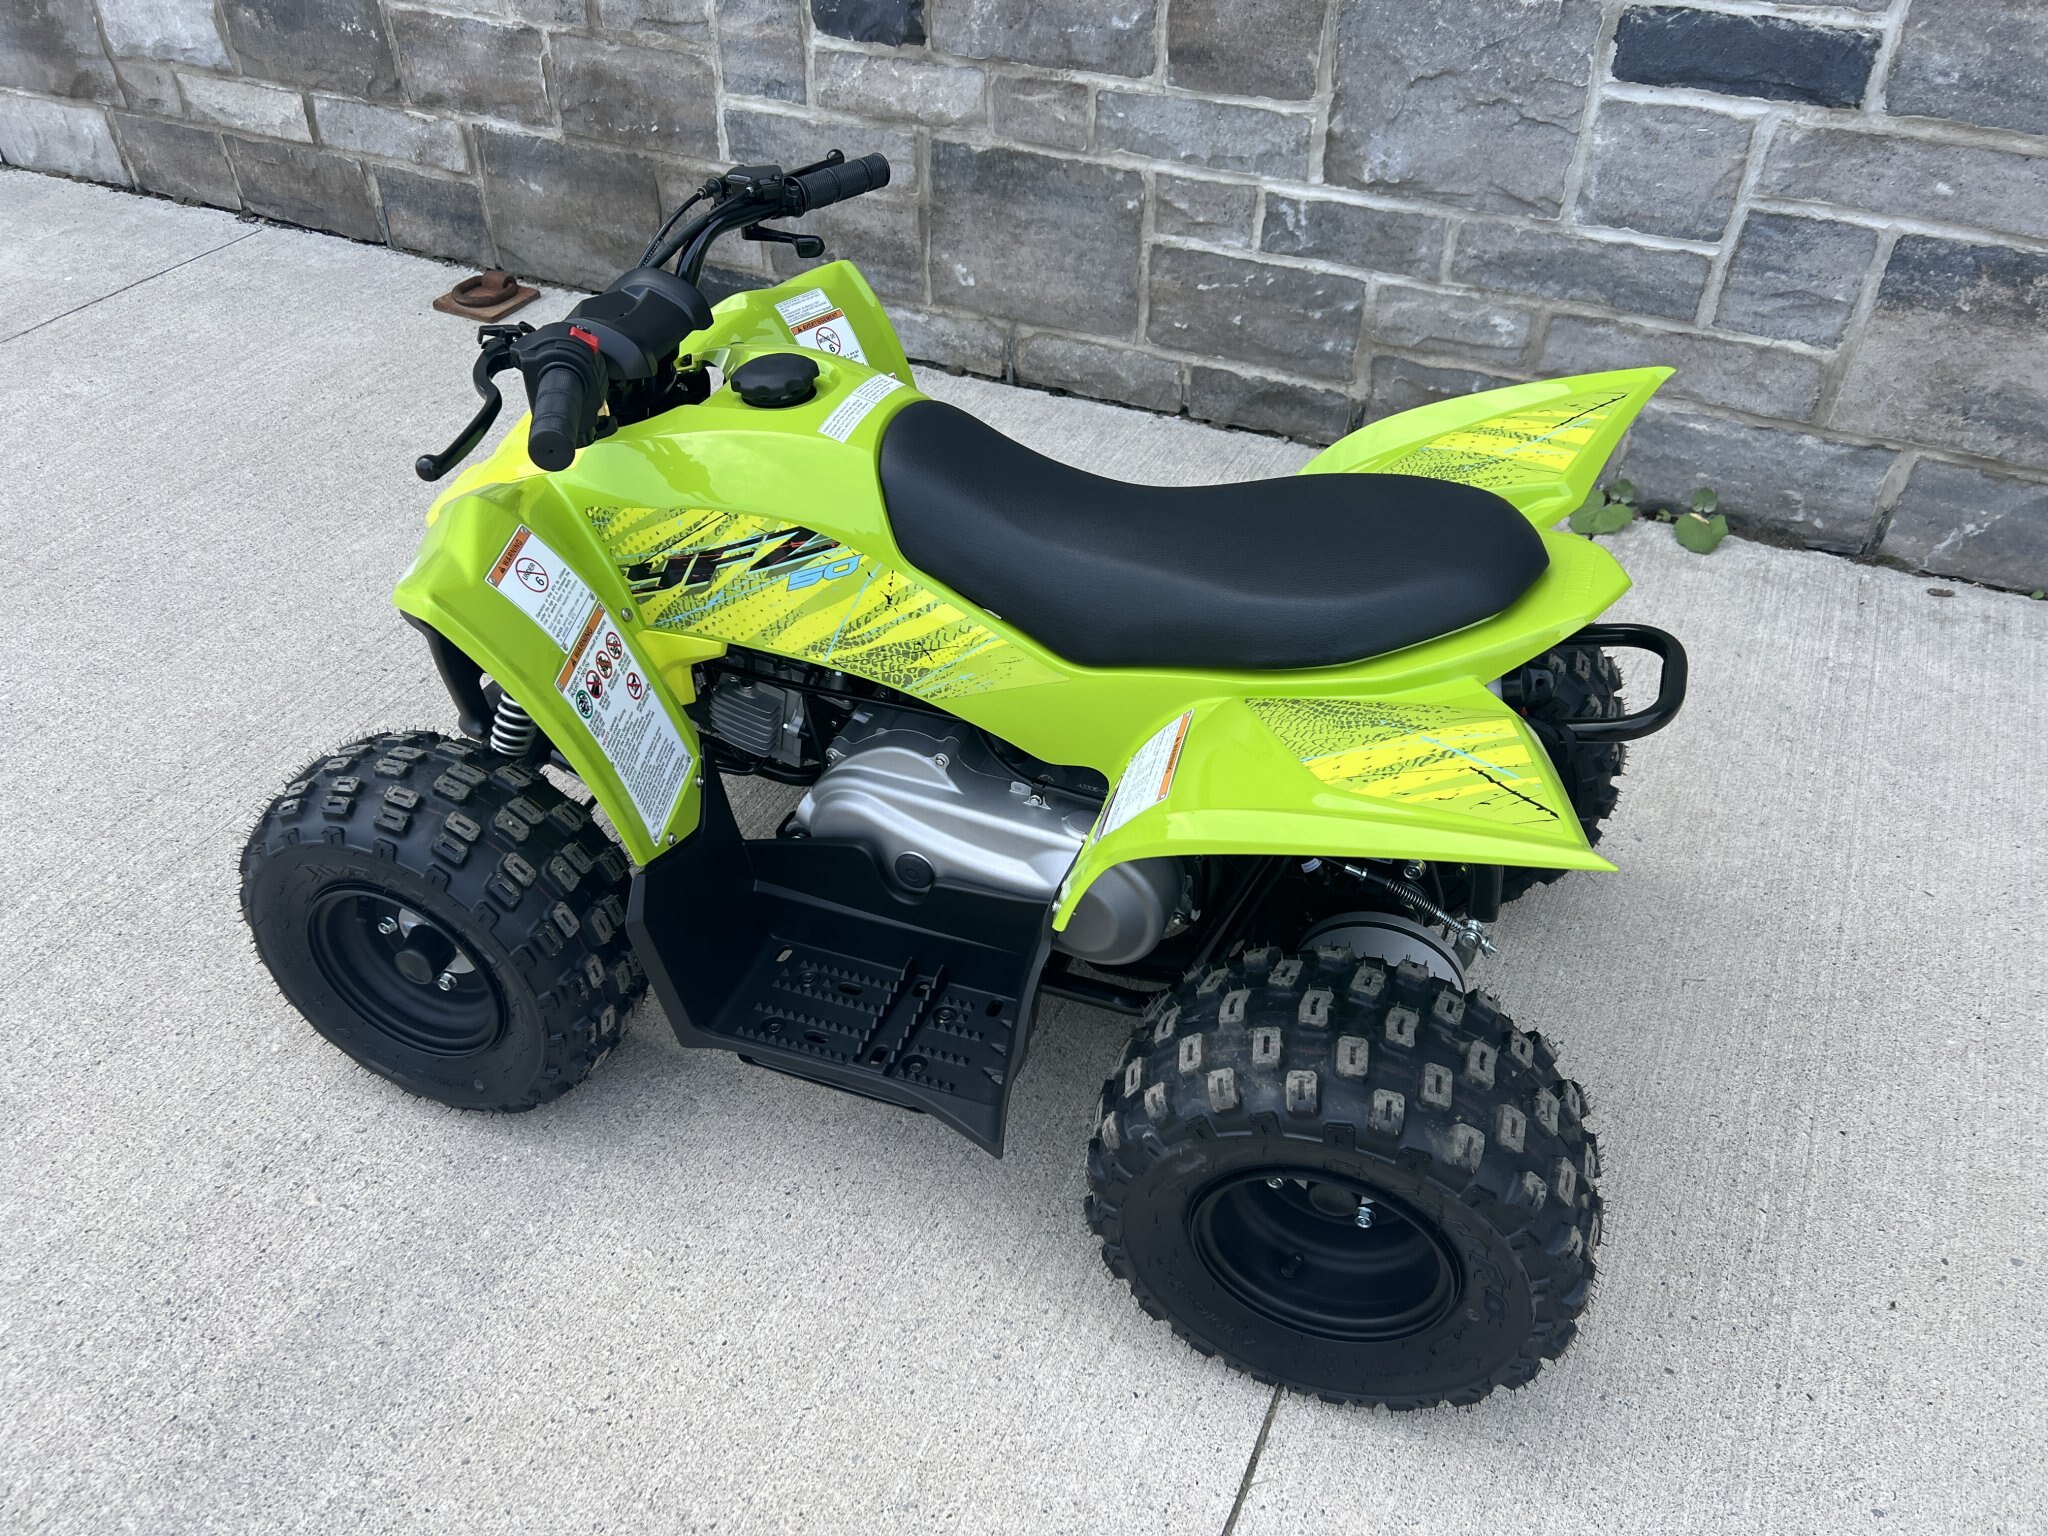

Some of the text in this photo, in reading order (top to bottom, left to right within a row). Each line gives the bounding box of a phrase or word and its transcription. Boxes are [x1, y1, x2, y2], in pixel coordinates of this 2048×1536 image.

[829, 344, 836, 353] 6
[502, 538, 523, 566] WARNING
[522, 562, 536, 581] UNDER
[536, 576, 545, 586] 6
[786, 553, 865, 592] 50
[574, 626, 593, 659] WARNING
